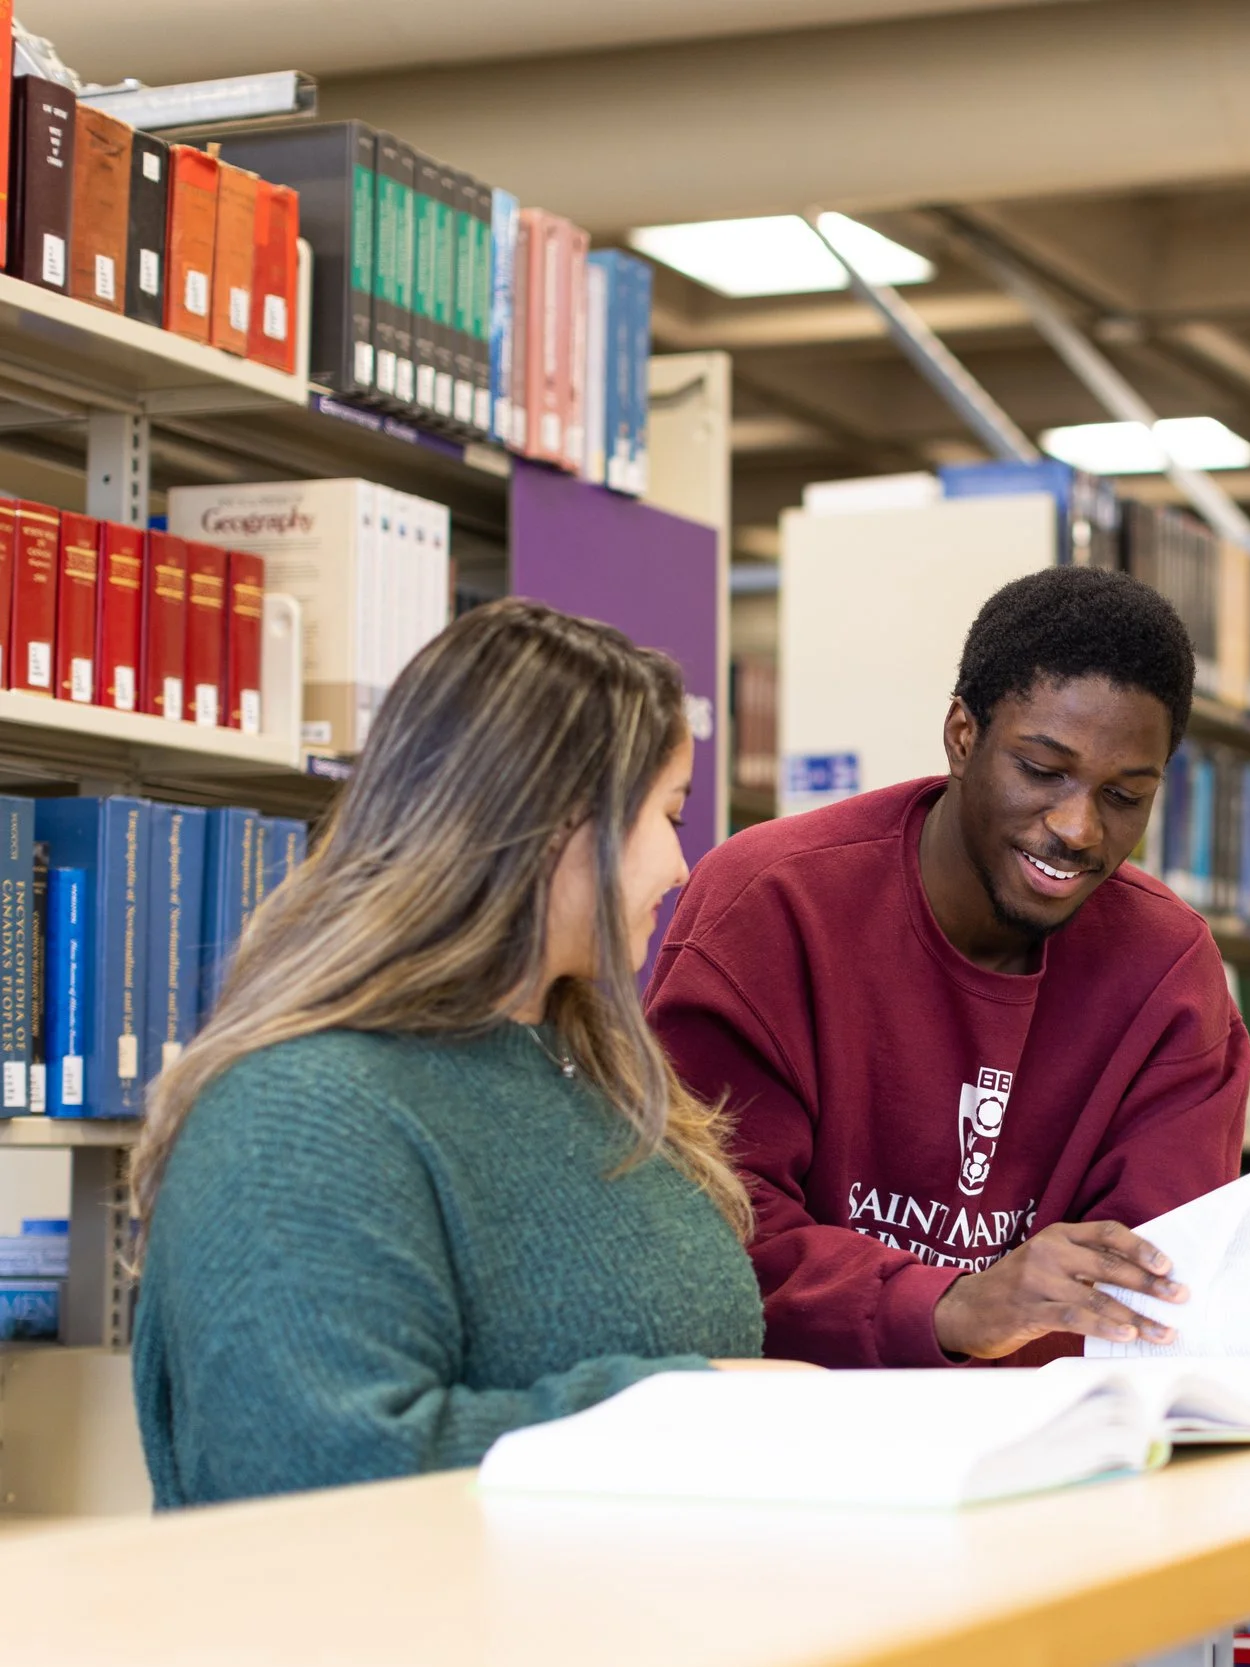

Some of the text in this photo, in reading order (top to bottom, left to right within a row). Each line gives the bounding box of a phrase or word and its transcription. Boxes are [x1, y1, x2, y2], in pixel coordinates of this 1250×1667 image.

[201, 505, 317, 537] Geography
[2, 879, 13, 1052] CANADA'S PEOPLES
[15, 880, 26, 1052] ENCYCLOPEDIA OF
[848, 1182, 1038, 1249] SAINT MARY'S
